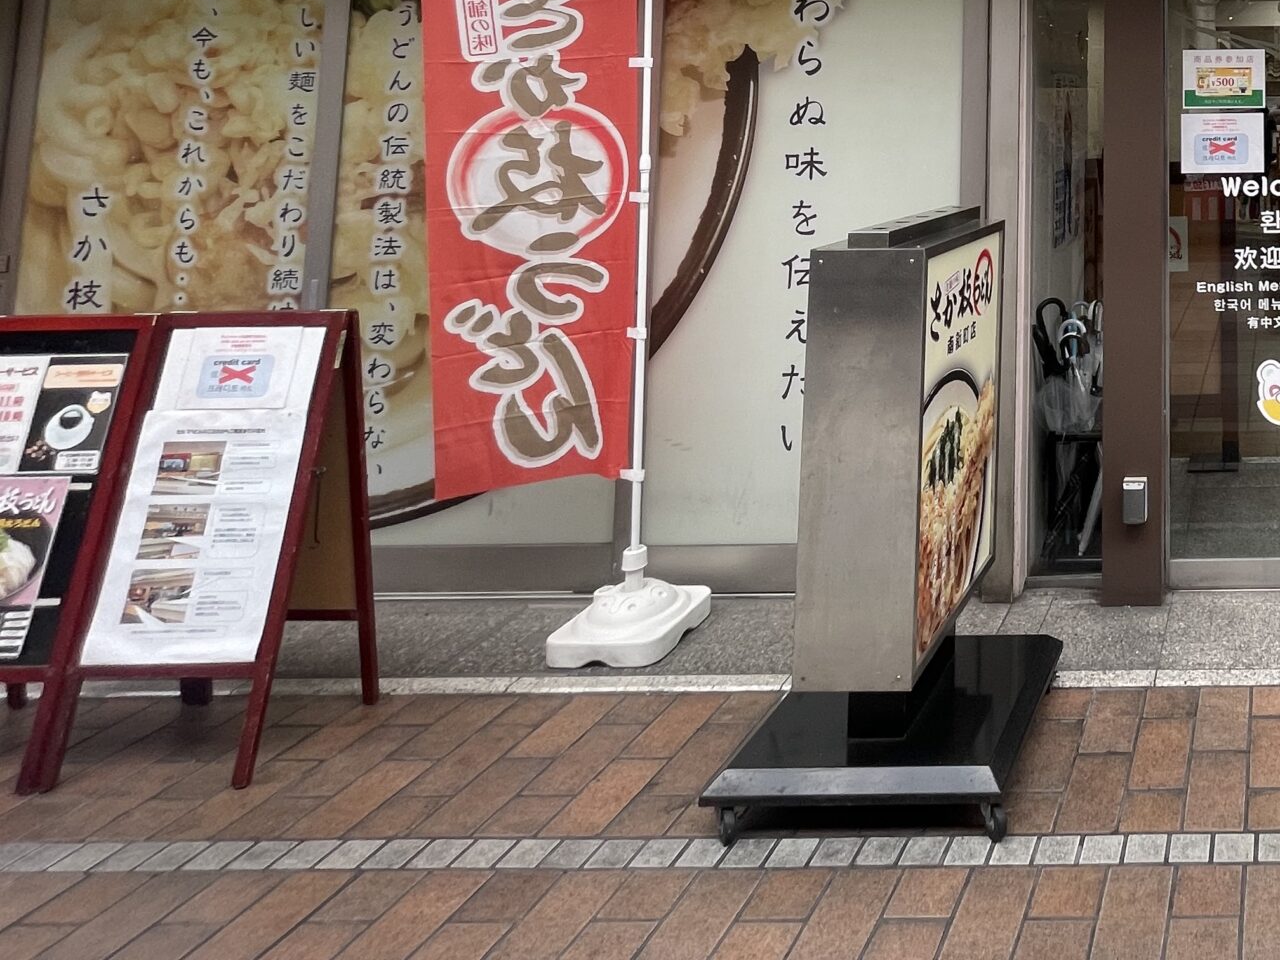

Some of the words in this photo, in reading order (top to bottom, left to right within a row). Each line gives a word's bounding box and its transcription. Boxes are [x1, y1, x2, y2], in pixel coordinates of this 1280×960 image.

[1211, 77, 1235, 87] ¥500
[67, 186, 111, 310] さか枝
[1196, 280, 1253, 294] English
[1213, 298, 1252, 311] 한국어
[213, 358, 239, 367] credit
[241, 358, 262, 366] card
